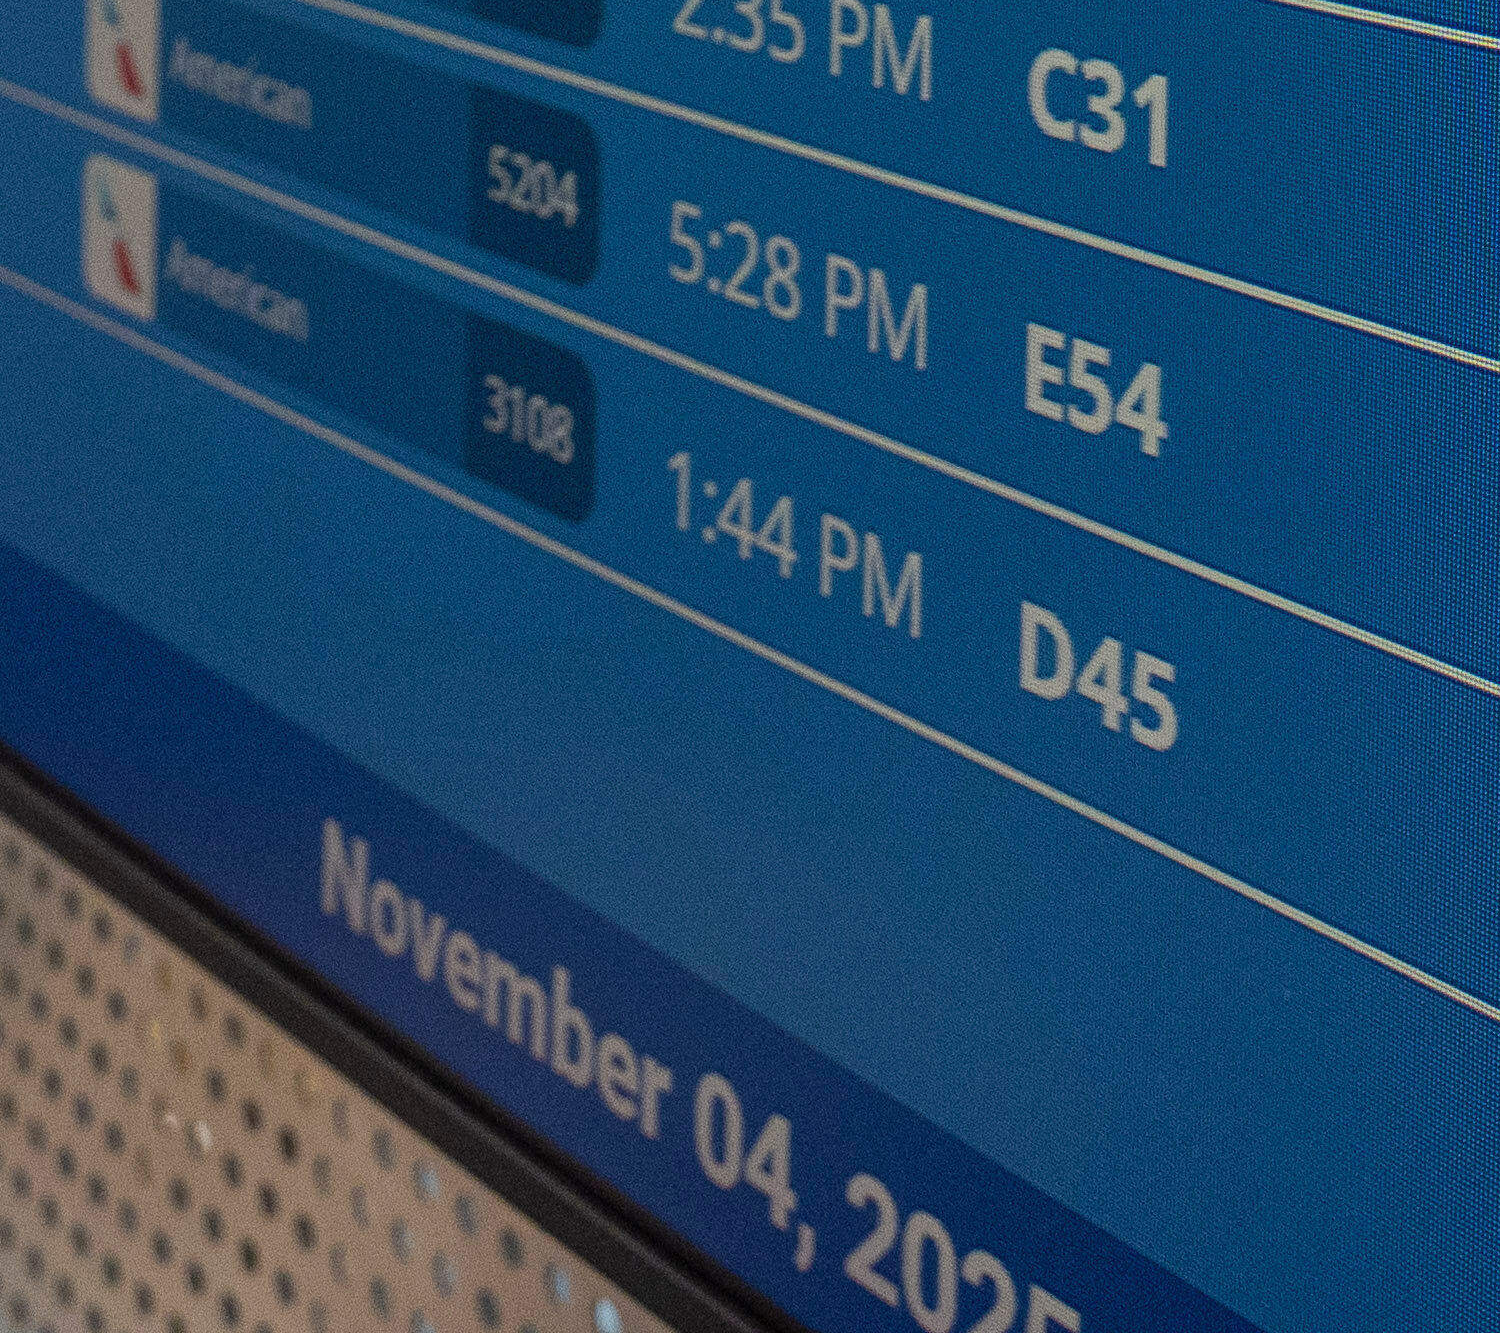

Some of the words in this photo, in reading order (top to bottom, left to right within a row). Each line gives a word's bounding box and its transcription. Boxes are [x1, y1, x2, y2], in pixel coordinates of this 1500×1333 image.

[170, 36, 313, 132] American
[486, 143, 580, 230] 5204
[667, 198, 802, 322] 5:28
[825, 252, 928, 371] PM
[1025, 322, 1169, 459] E54
[1027, 48, 1170, 168] C31
[166, 237, 311, 343] American
[482, 374, 575, 469] 3108
[666, 450, 797, 579] 1:44
[818, 512, 924, 639] PM
[1018, 600, 1179, 752] D45
[320, 818, 678, 1143] November
[694, 1070, 815, 1273] 04,
